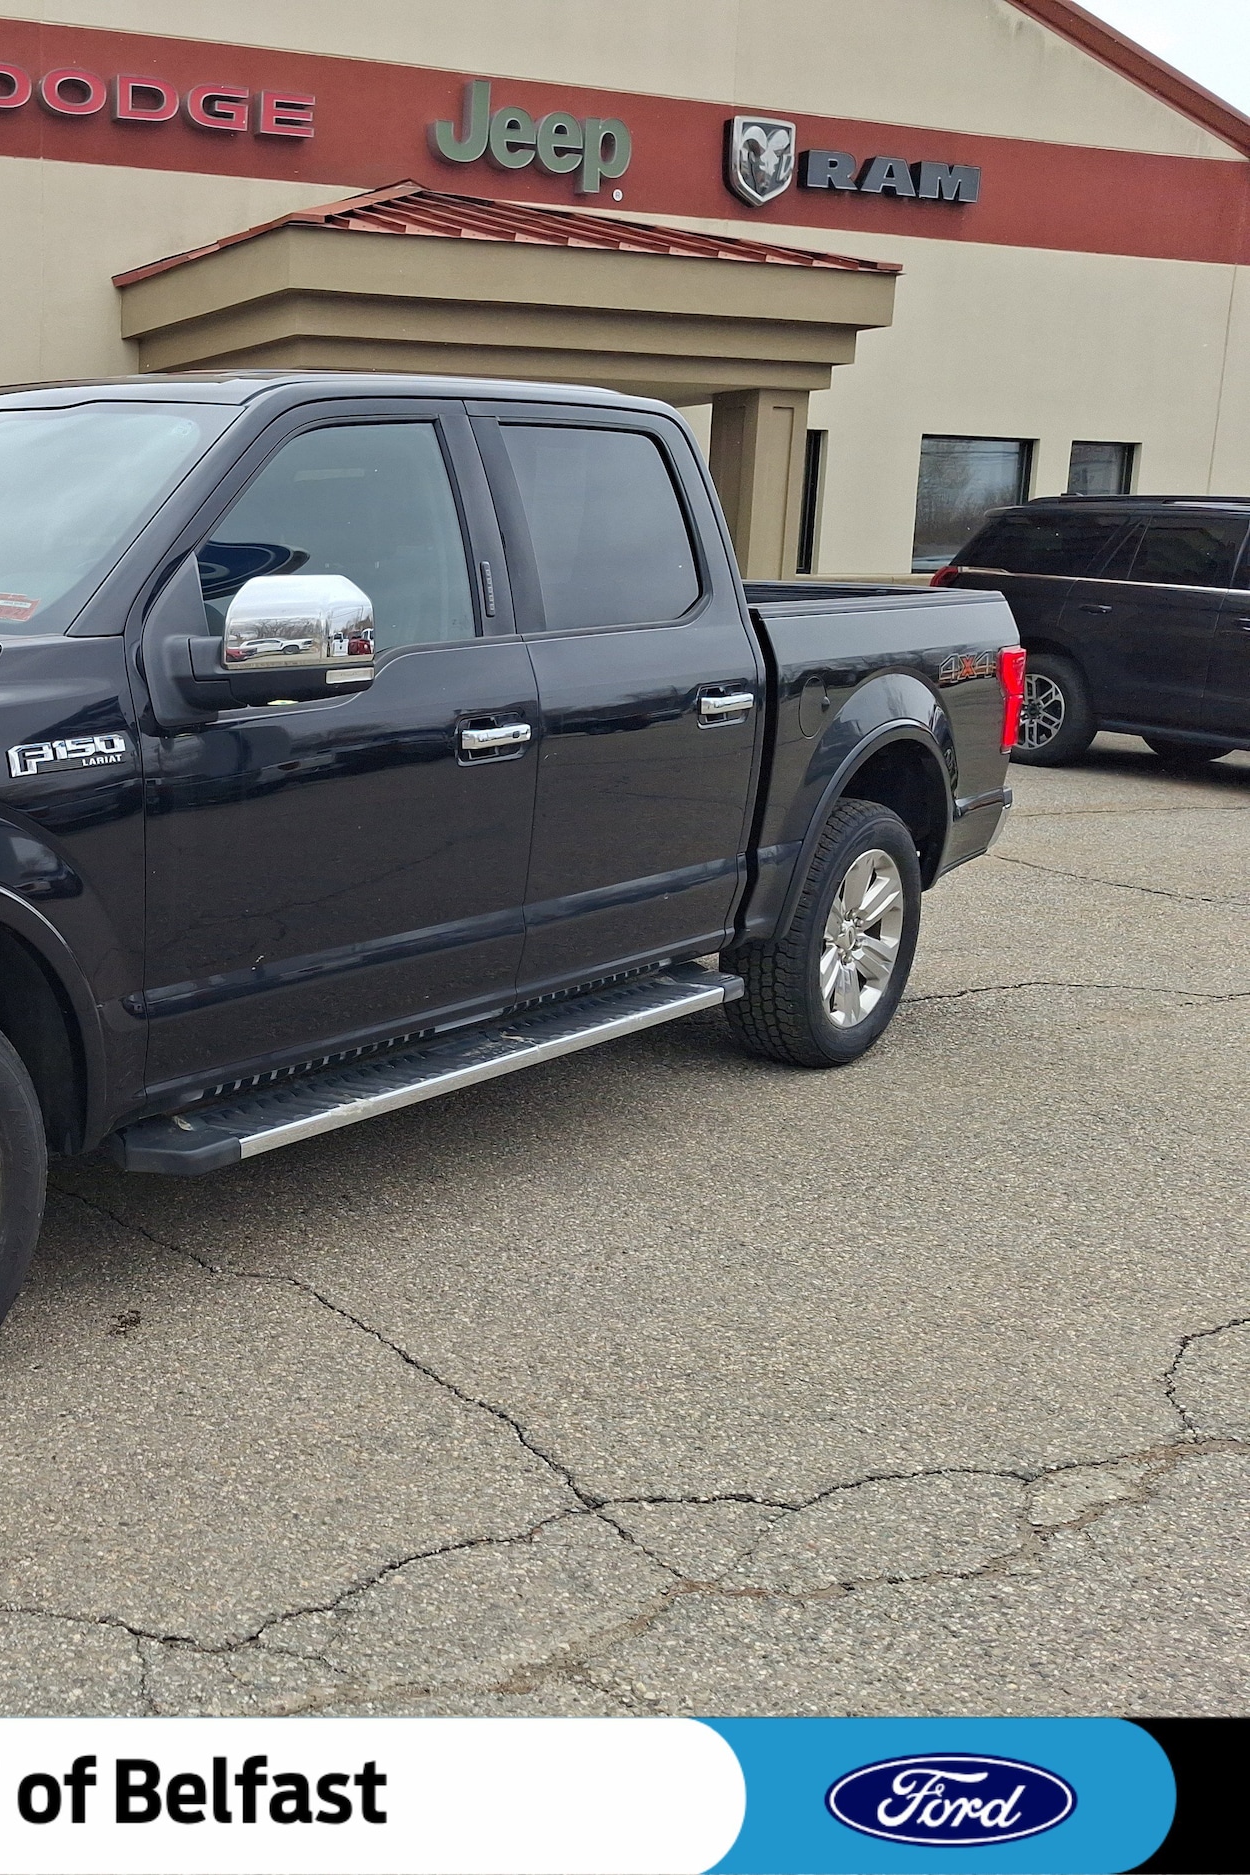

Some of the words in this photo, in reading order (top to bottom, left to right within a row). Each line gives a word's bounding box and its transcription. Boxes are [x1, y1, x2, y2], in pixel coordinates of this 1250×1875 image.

[434, 80, 632, 194] Jeep
[799, 149, 982, 203] RAM
[82, 754, 122, 766] LARIAT
